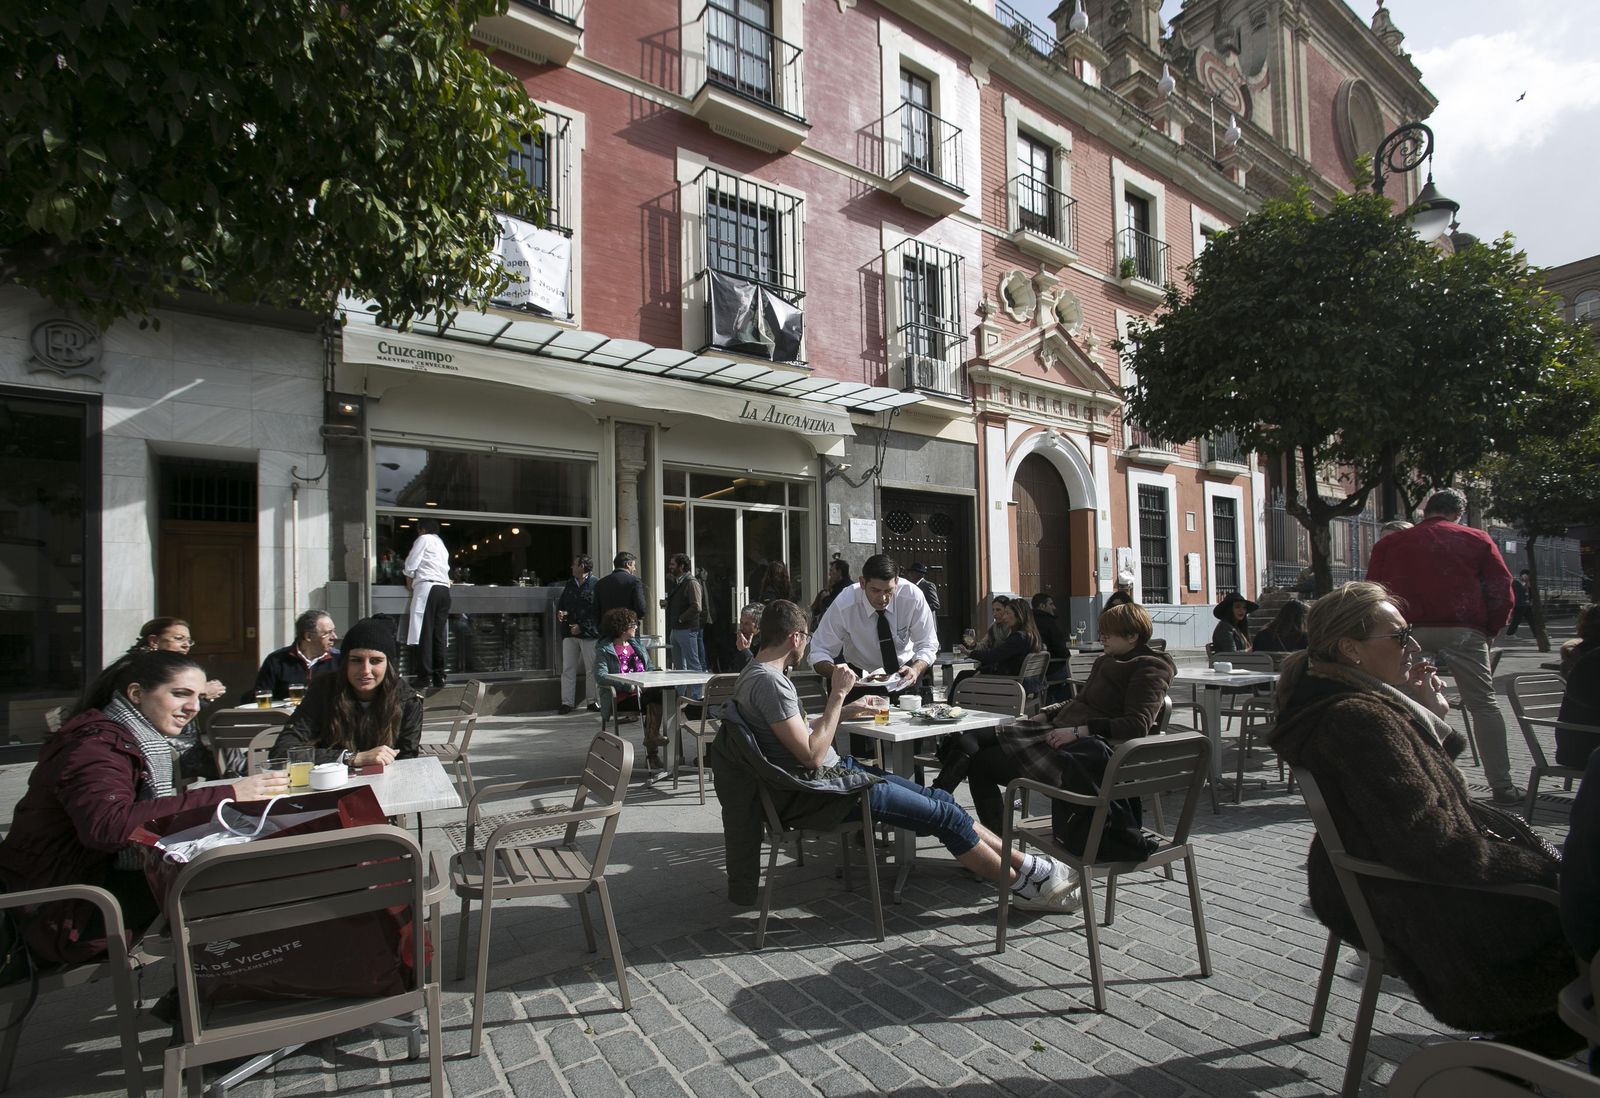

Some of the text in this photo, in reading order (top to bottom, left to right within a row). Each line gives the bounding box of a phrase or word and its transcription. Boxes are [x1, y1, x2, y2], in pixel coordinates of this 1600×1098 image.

[376, 355, 414, 364] MAESTROS
[416, 360, 459, 371] CERVECEROS
[377, 341, 453, 363] Cruzcampo
[739, 400, 836, 433] LA ALICANTINA
[211, 961, 232, 971] DE
[235, 940, 303, 965] VICENTE
[222, 957, 284, 976] COMPLEMENTOS
